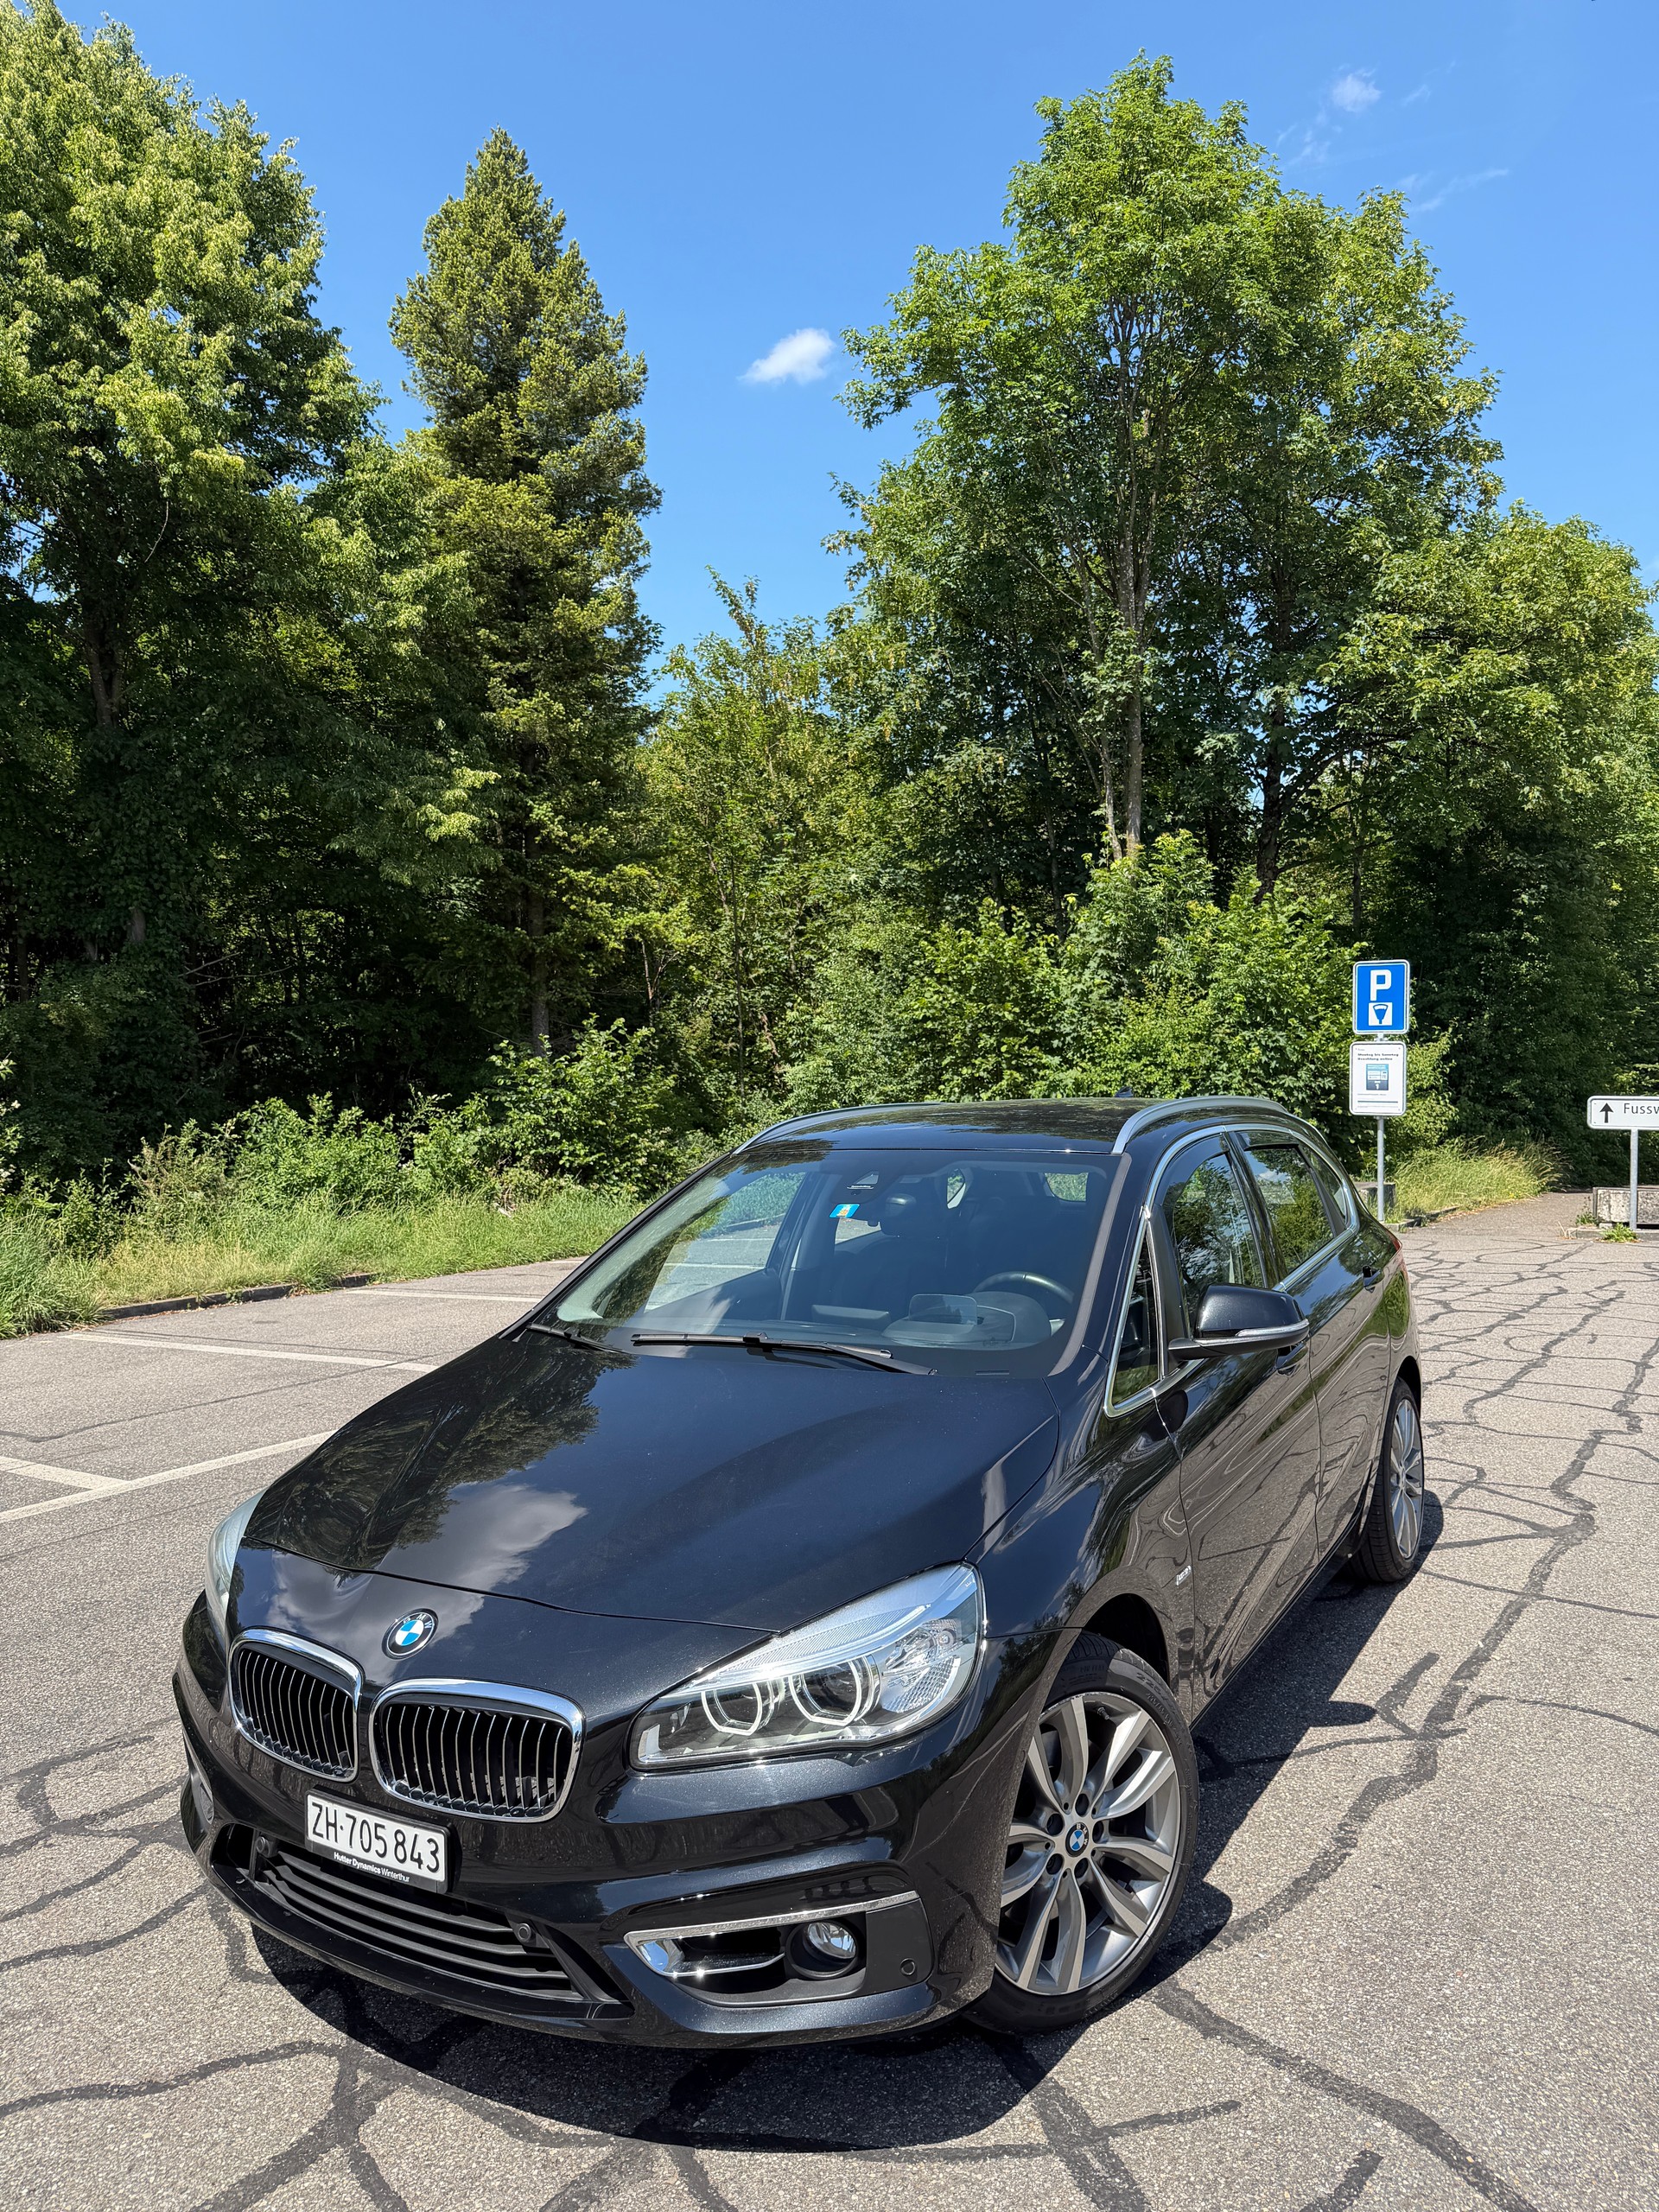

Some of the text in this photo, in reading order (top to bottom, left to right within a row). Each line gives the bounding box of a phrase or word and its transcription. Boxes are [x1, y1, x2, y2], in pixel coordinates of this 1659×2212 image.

[1370, 969, 1392, 1001] P
[403, 1613, 433, 1629] BMW
[1076, 1823, 1089, 1846] BMW
[394, 1828, 440, 1873] 843
[334, 1852, 410, 1883] Hutter Dynamics Winterthur
